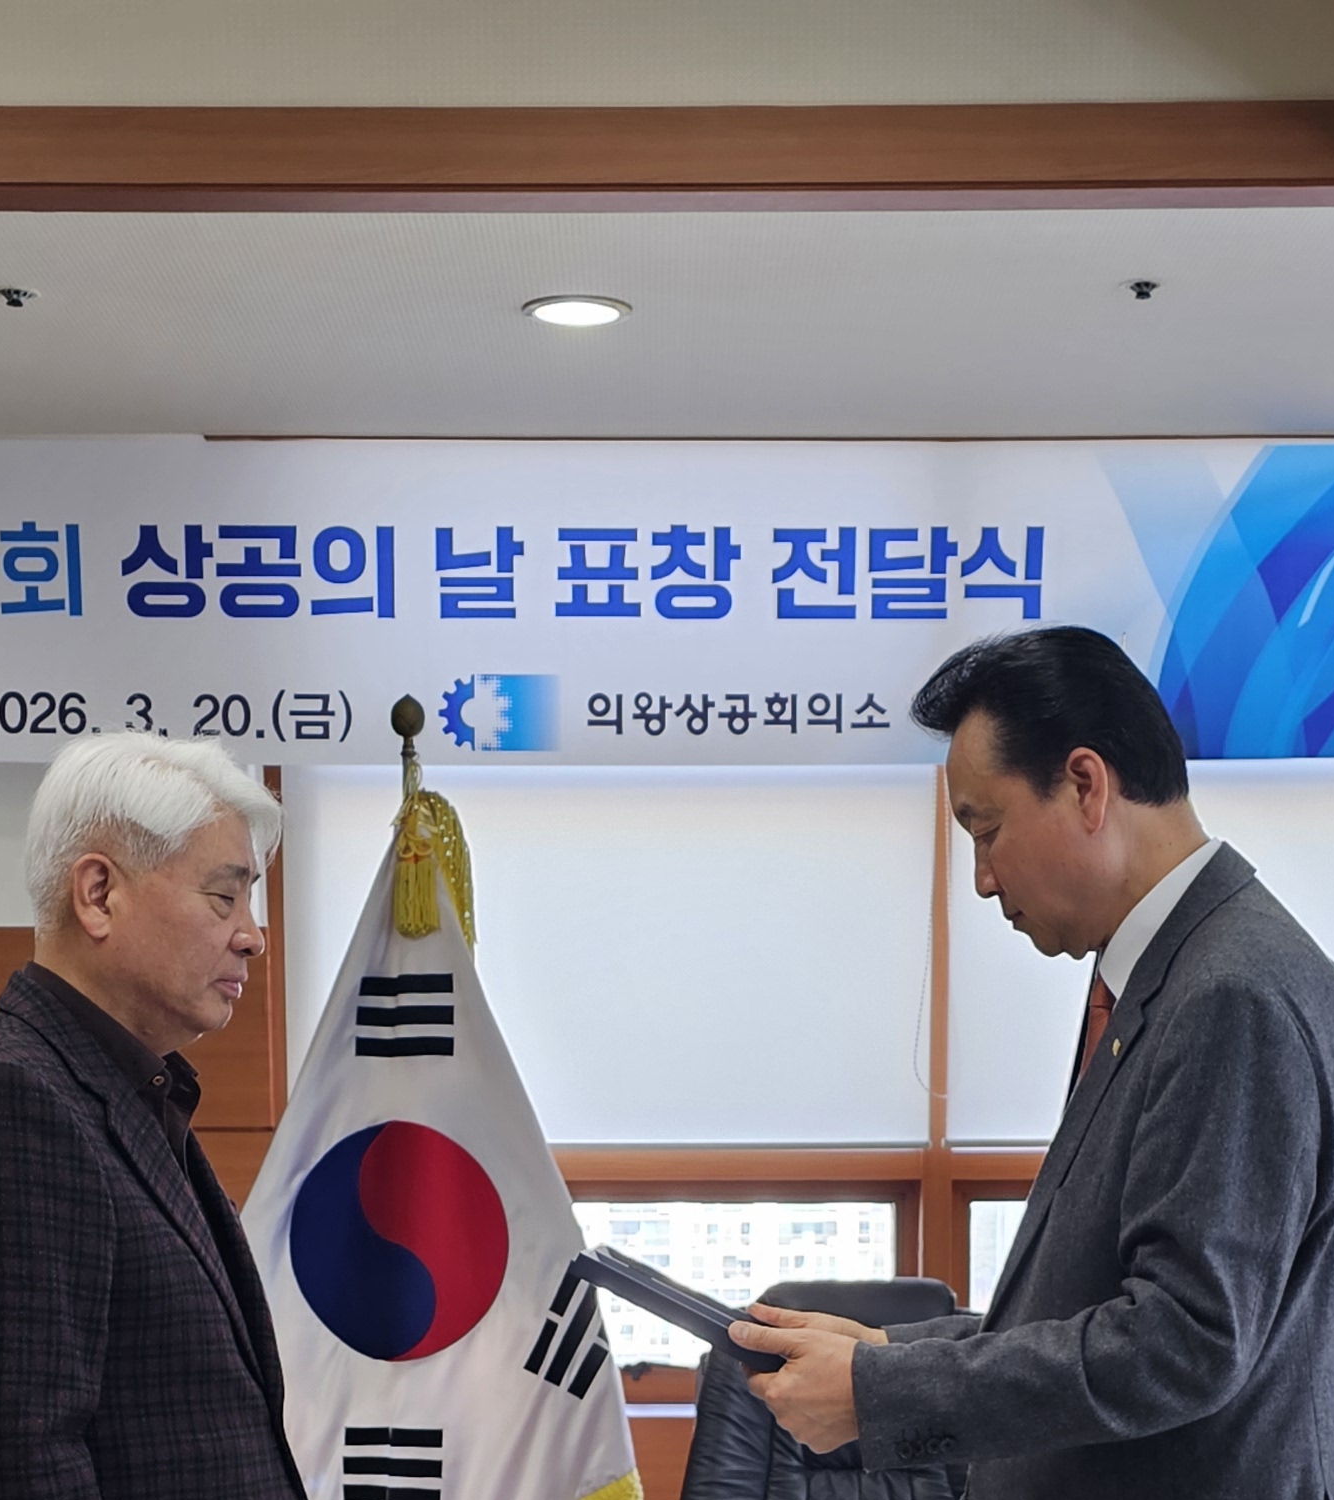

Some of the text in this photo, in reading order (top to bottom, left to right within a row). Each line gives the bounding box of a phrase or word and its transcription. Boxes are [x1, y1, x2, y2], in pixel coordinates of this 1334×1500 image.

[120, 523, 396, 619] 상공의
[435, 526, 526, 619] 날
[555, 524, 743, 620] 표창
[771, 525, 1045, 620] 전달식
[126, 692, 168, 737] 3.
[587, 691, 892, 736] 의왕상공회의소
